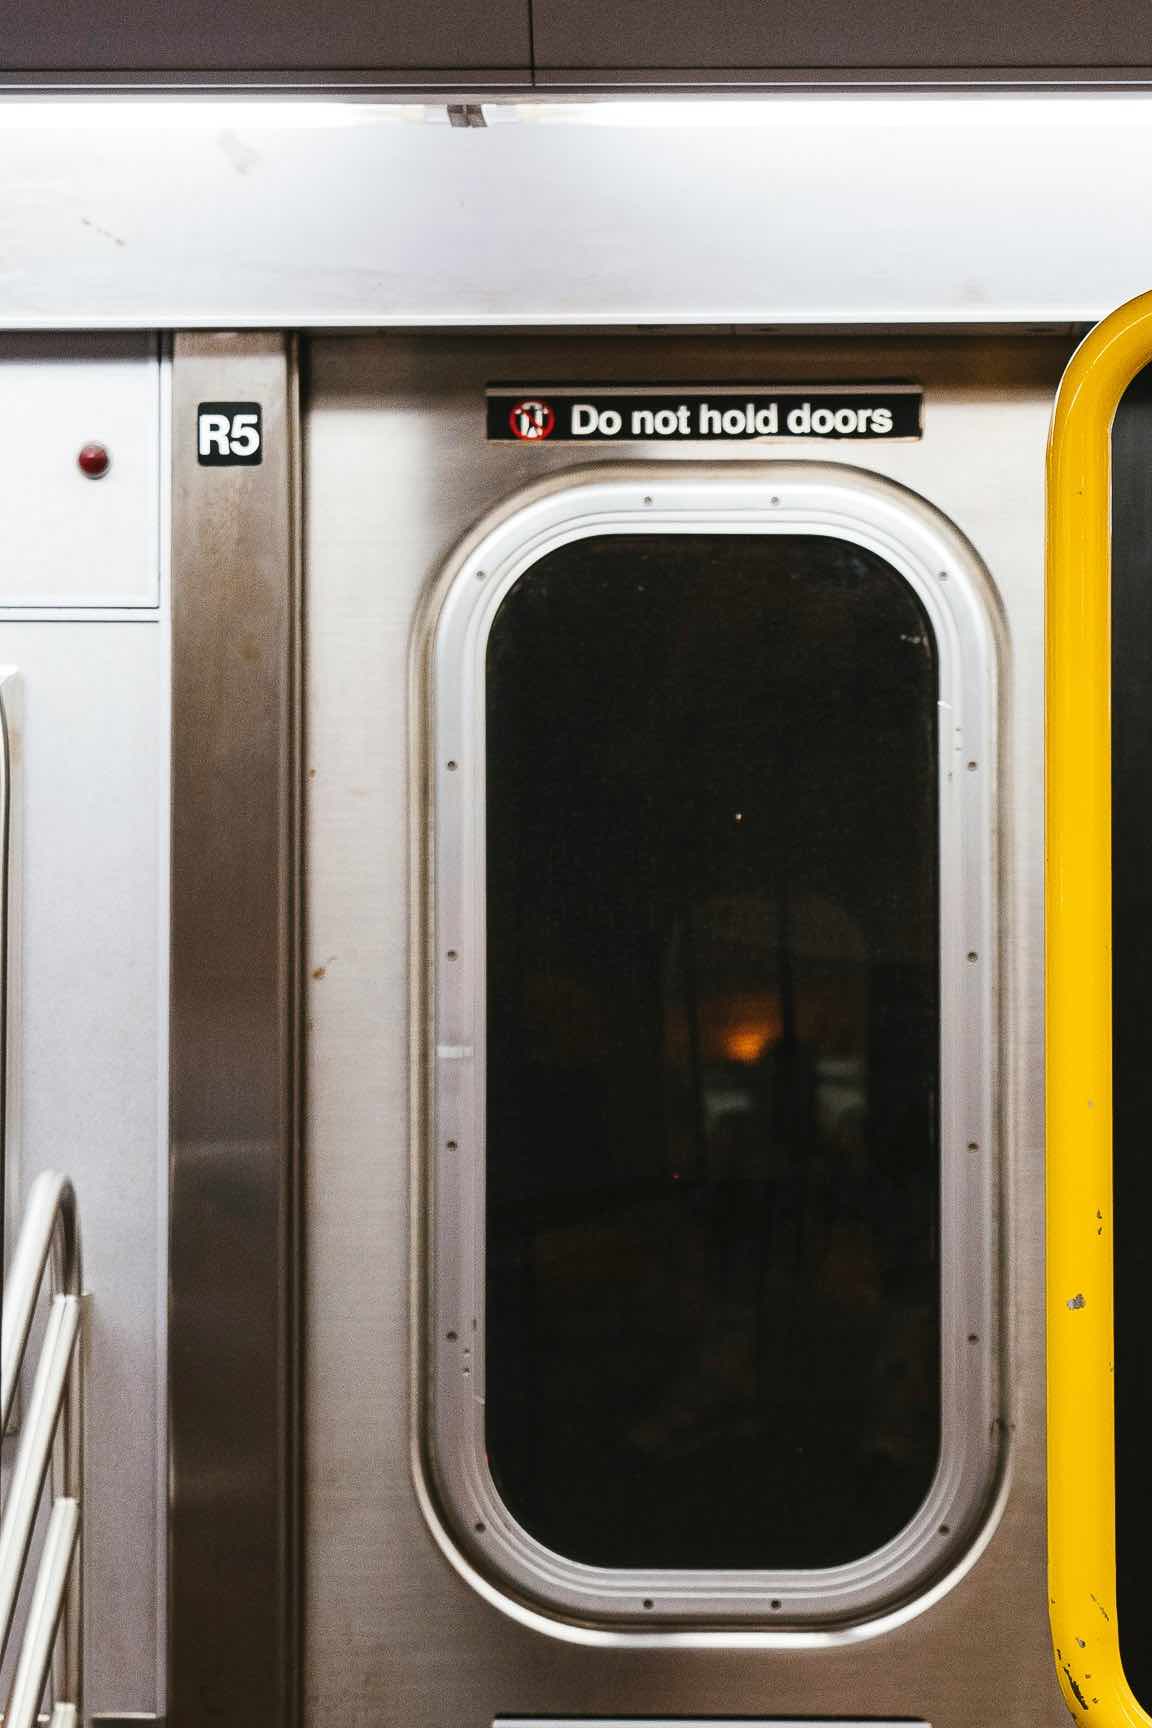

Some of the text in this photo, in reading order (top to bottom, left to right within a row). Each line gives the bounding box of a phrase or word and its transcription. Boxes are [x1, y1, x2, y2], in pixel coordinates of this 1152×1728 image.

[199, 414, 261, 456] R5
[571, 402, 894, 435] Do not hold doors
